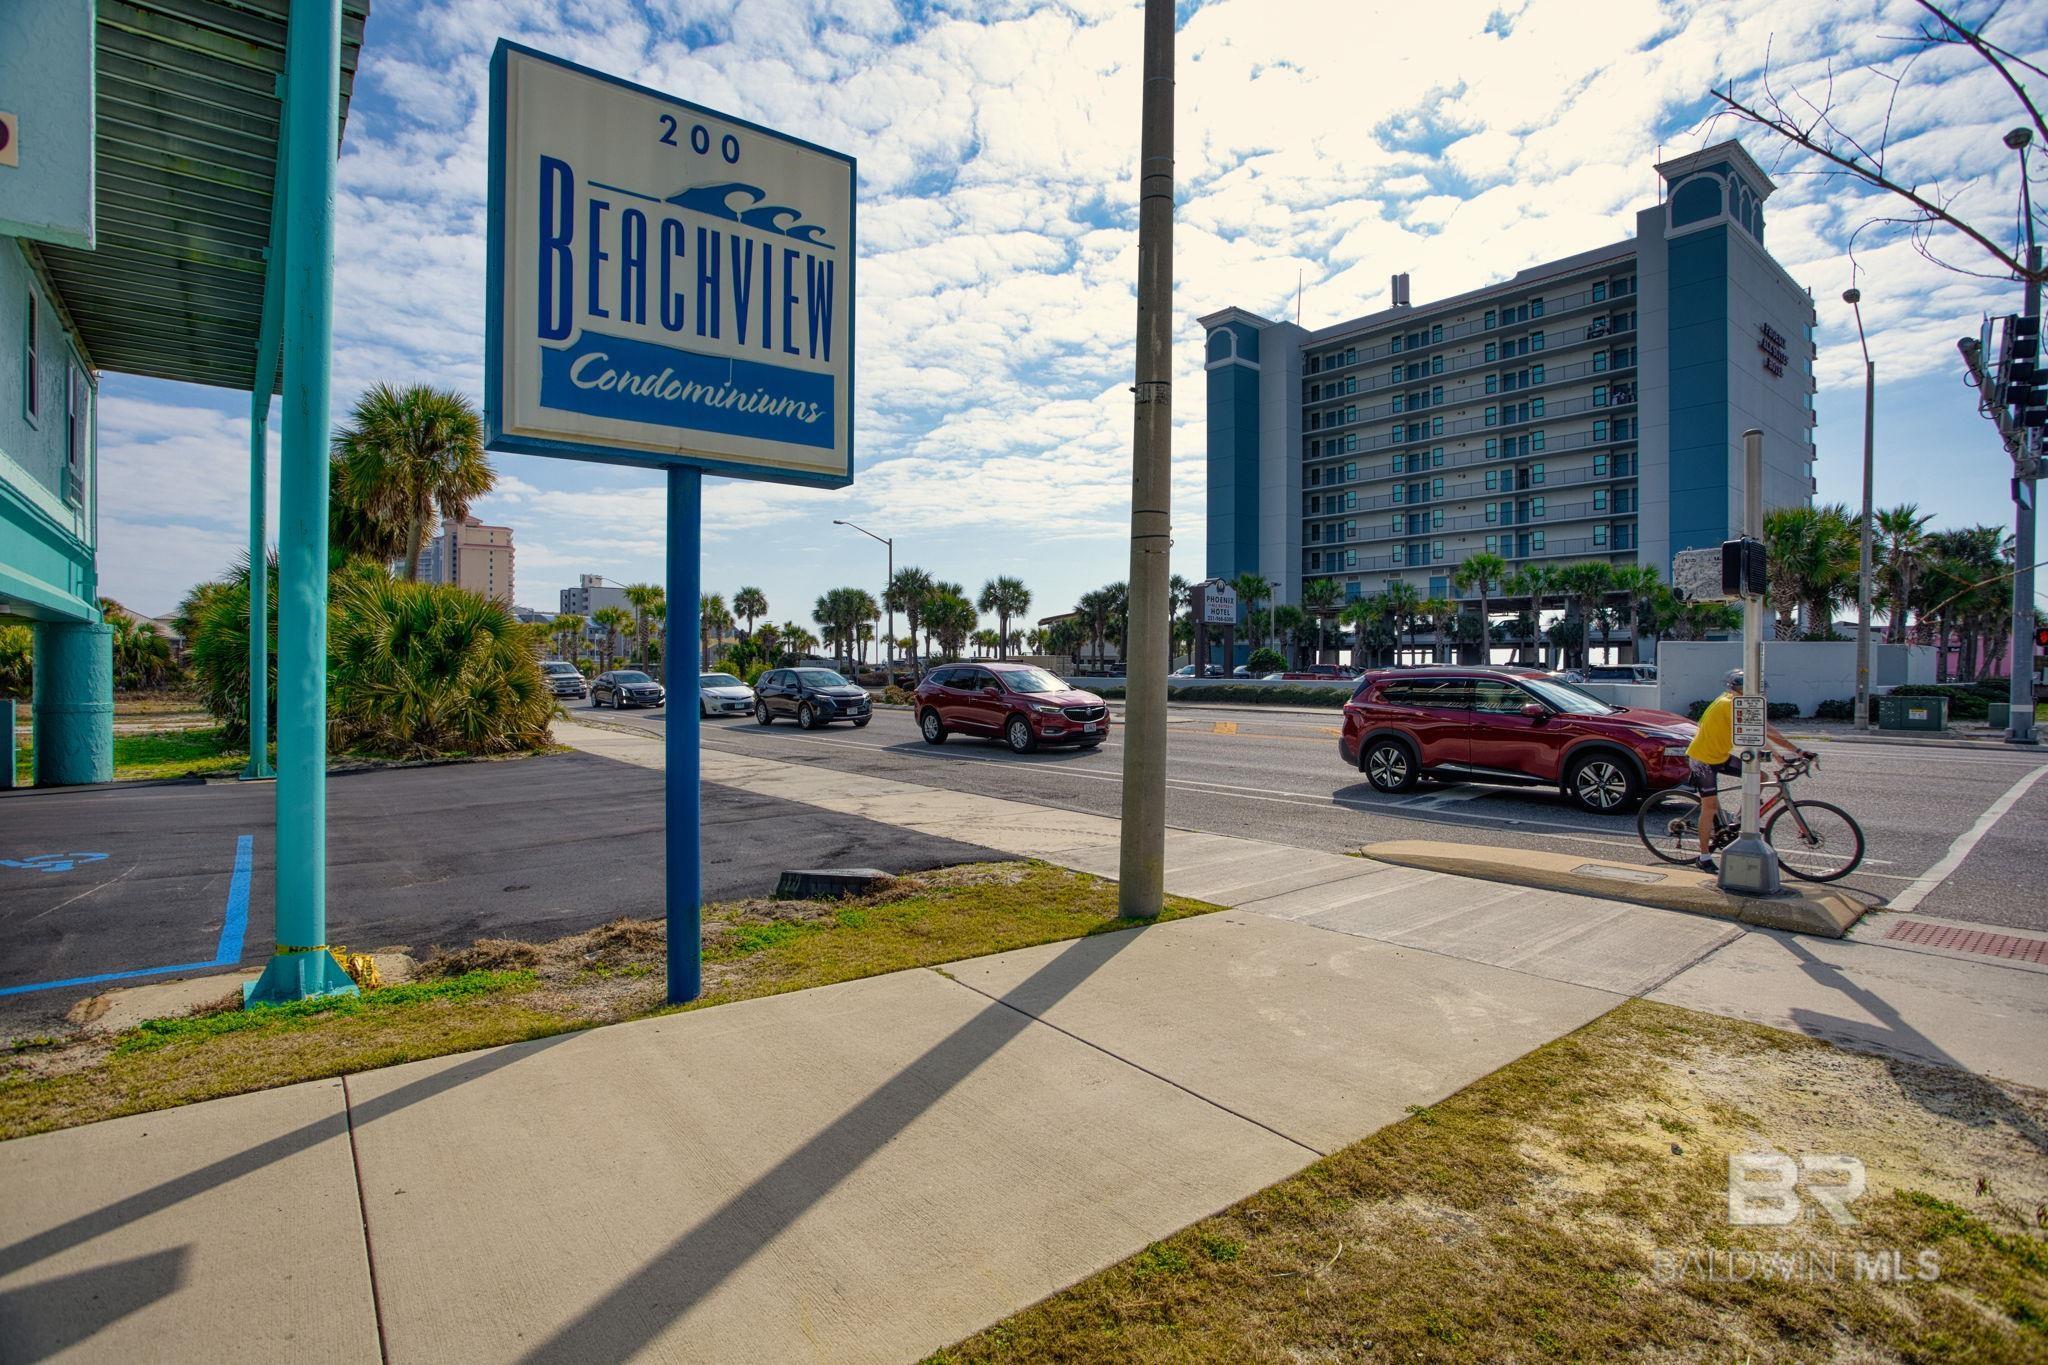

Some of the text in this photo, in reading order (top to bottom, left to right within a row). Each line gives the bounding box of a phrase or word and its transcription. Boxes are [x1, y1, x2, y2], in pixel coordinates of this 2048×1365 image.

[659, 113, 740, 164] 200
[537, 153, 835, 363] BEACHVIEW
[569, 352, 826, 424] Condominiums
[1206, 596, 1234, 604] PHOENIX
